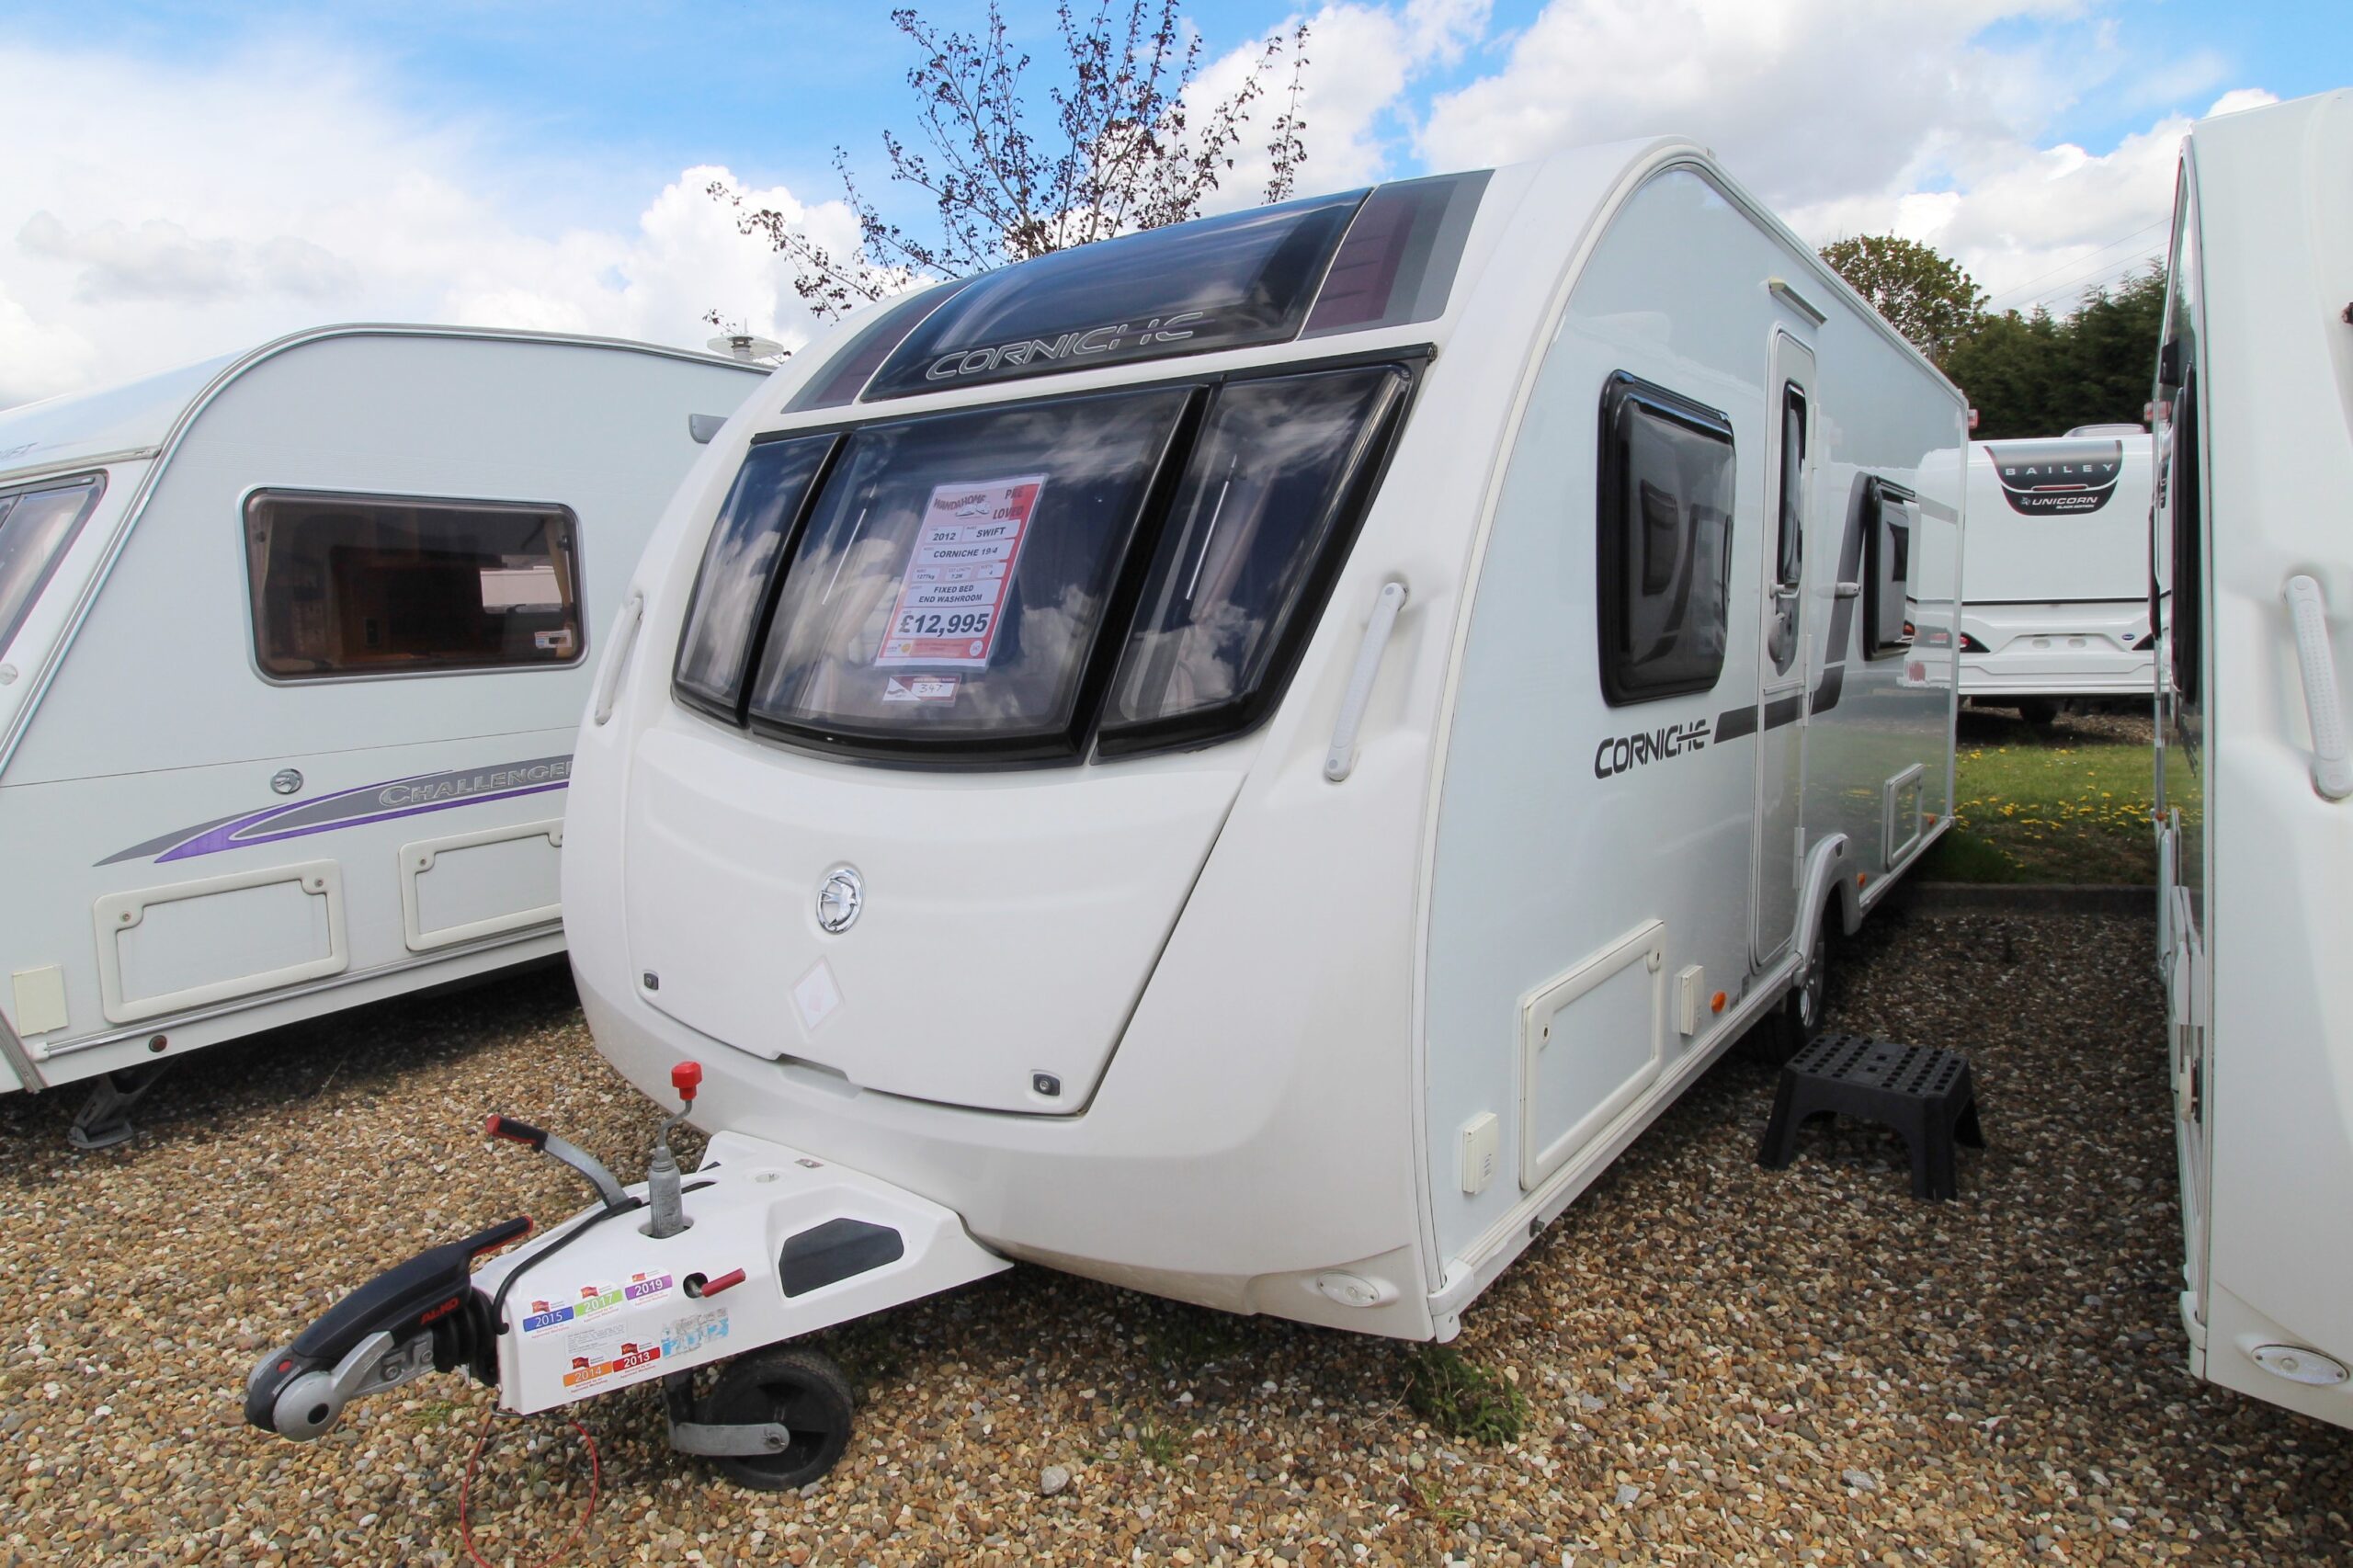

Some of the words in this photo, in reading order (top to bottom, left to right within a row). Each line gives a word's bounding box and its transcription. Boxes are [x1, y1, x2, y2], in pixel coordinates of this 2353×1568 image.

[926, 312, 1204, 381] CORNICHE
[2006, 463, 2113, 476] BAILEY
[1005, 487, 1024, 499] PRE
[933, 494, 987, 511] WANDAHOME
[2031, 496, 2098, 506] UNICORN
[993, 506, 1024, 519] LOVED
[932, 532, 956, 541] 2012
[976, 527, 1006, 538] SWIFT
[934, 549, 979, 558] CORNICHE
[959, 585, 974, 593] BED
[937, 594, 983, 603] WASHROOM
[898, 613, 990, 637] £12,995
[1594, 719, 1711, 779] CORNICHE
[634, 1278, 663, 1296] 2019
[584, 1293, 613, 1313] 2017
[535, 1311, 563, 1327] 2015
[623, 1351, 651, 1369] 2013
[574, 1366, 602, 1382] 2014
